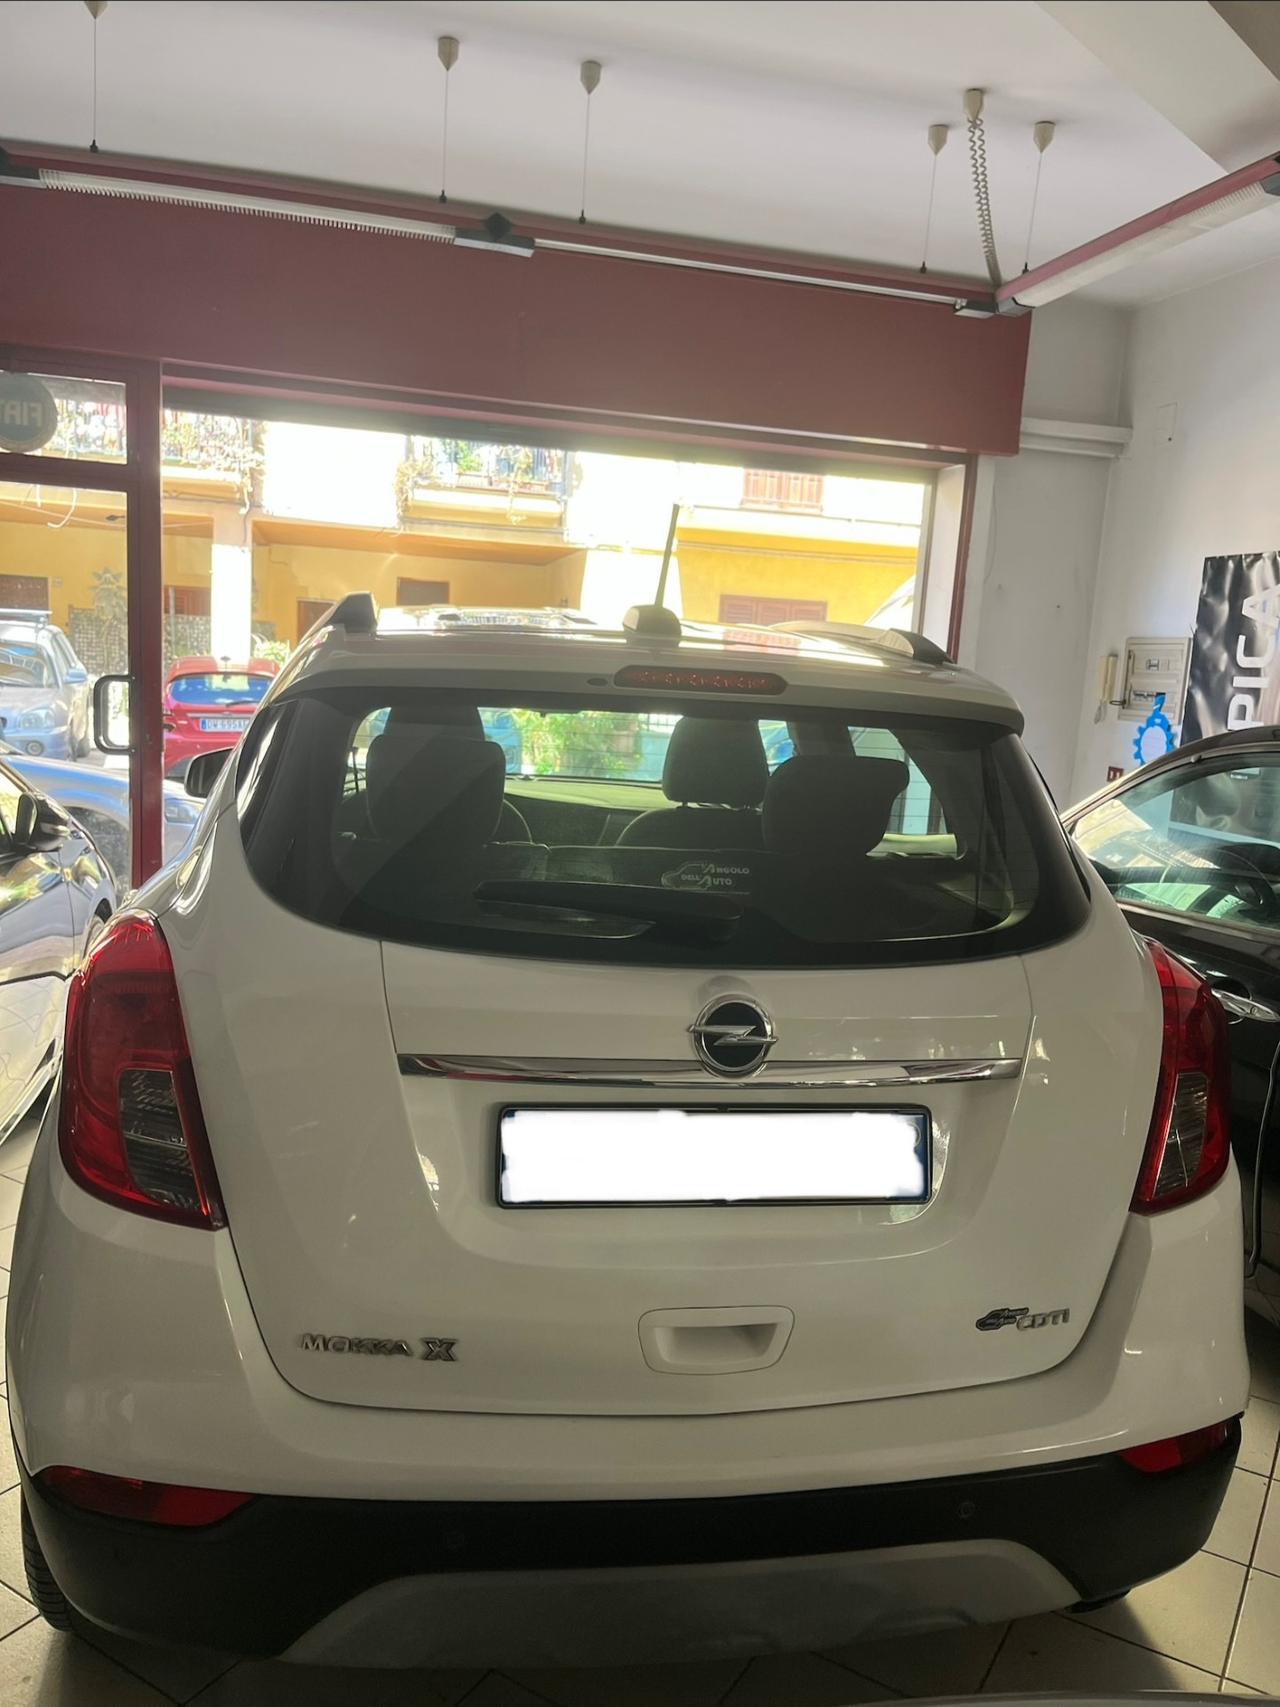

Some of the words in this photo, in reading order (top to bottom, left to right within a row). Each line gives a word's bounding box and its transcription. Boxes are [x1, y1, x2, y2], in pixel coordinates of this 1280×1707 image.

[1016, 1308, 1070, 1331] CDTI
[300, 1333, 413, 1356] MOKKA
[421, 1337, 457, 1361] X
